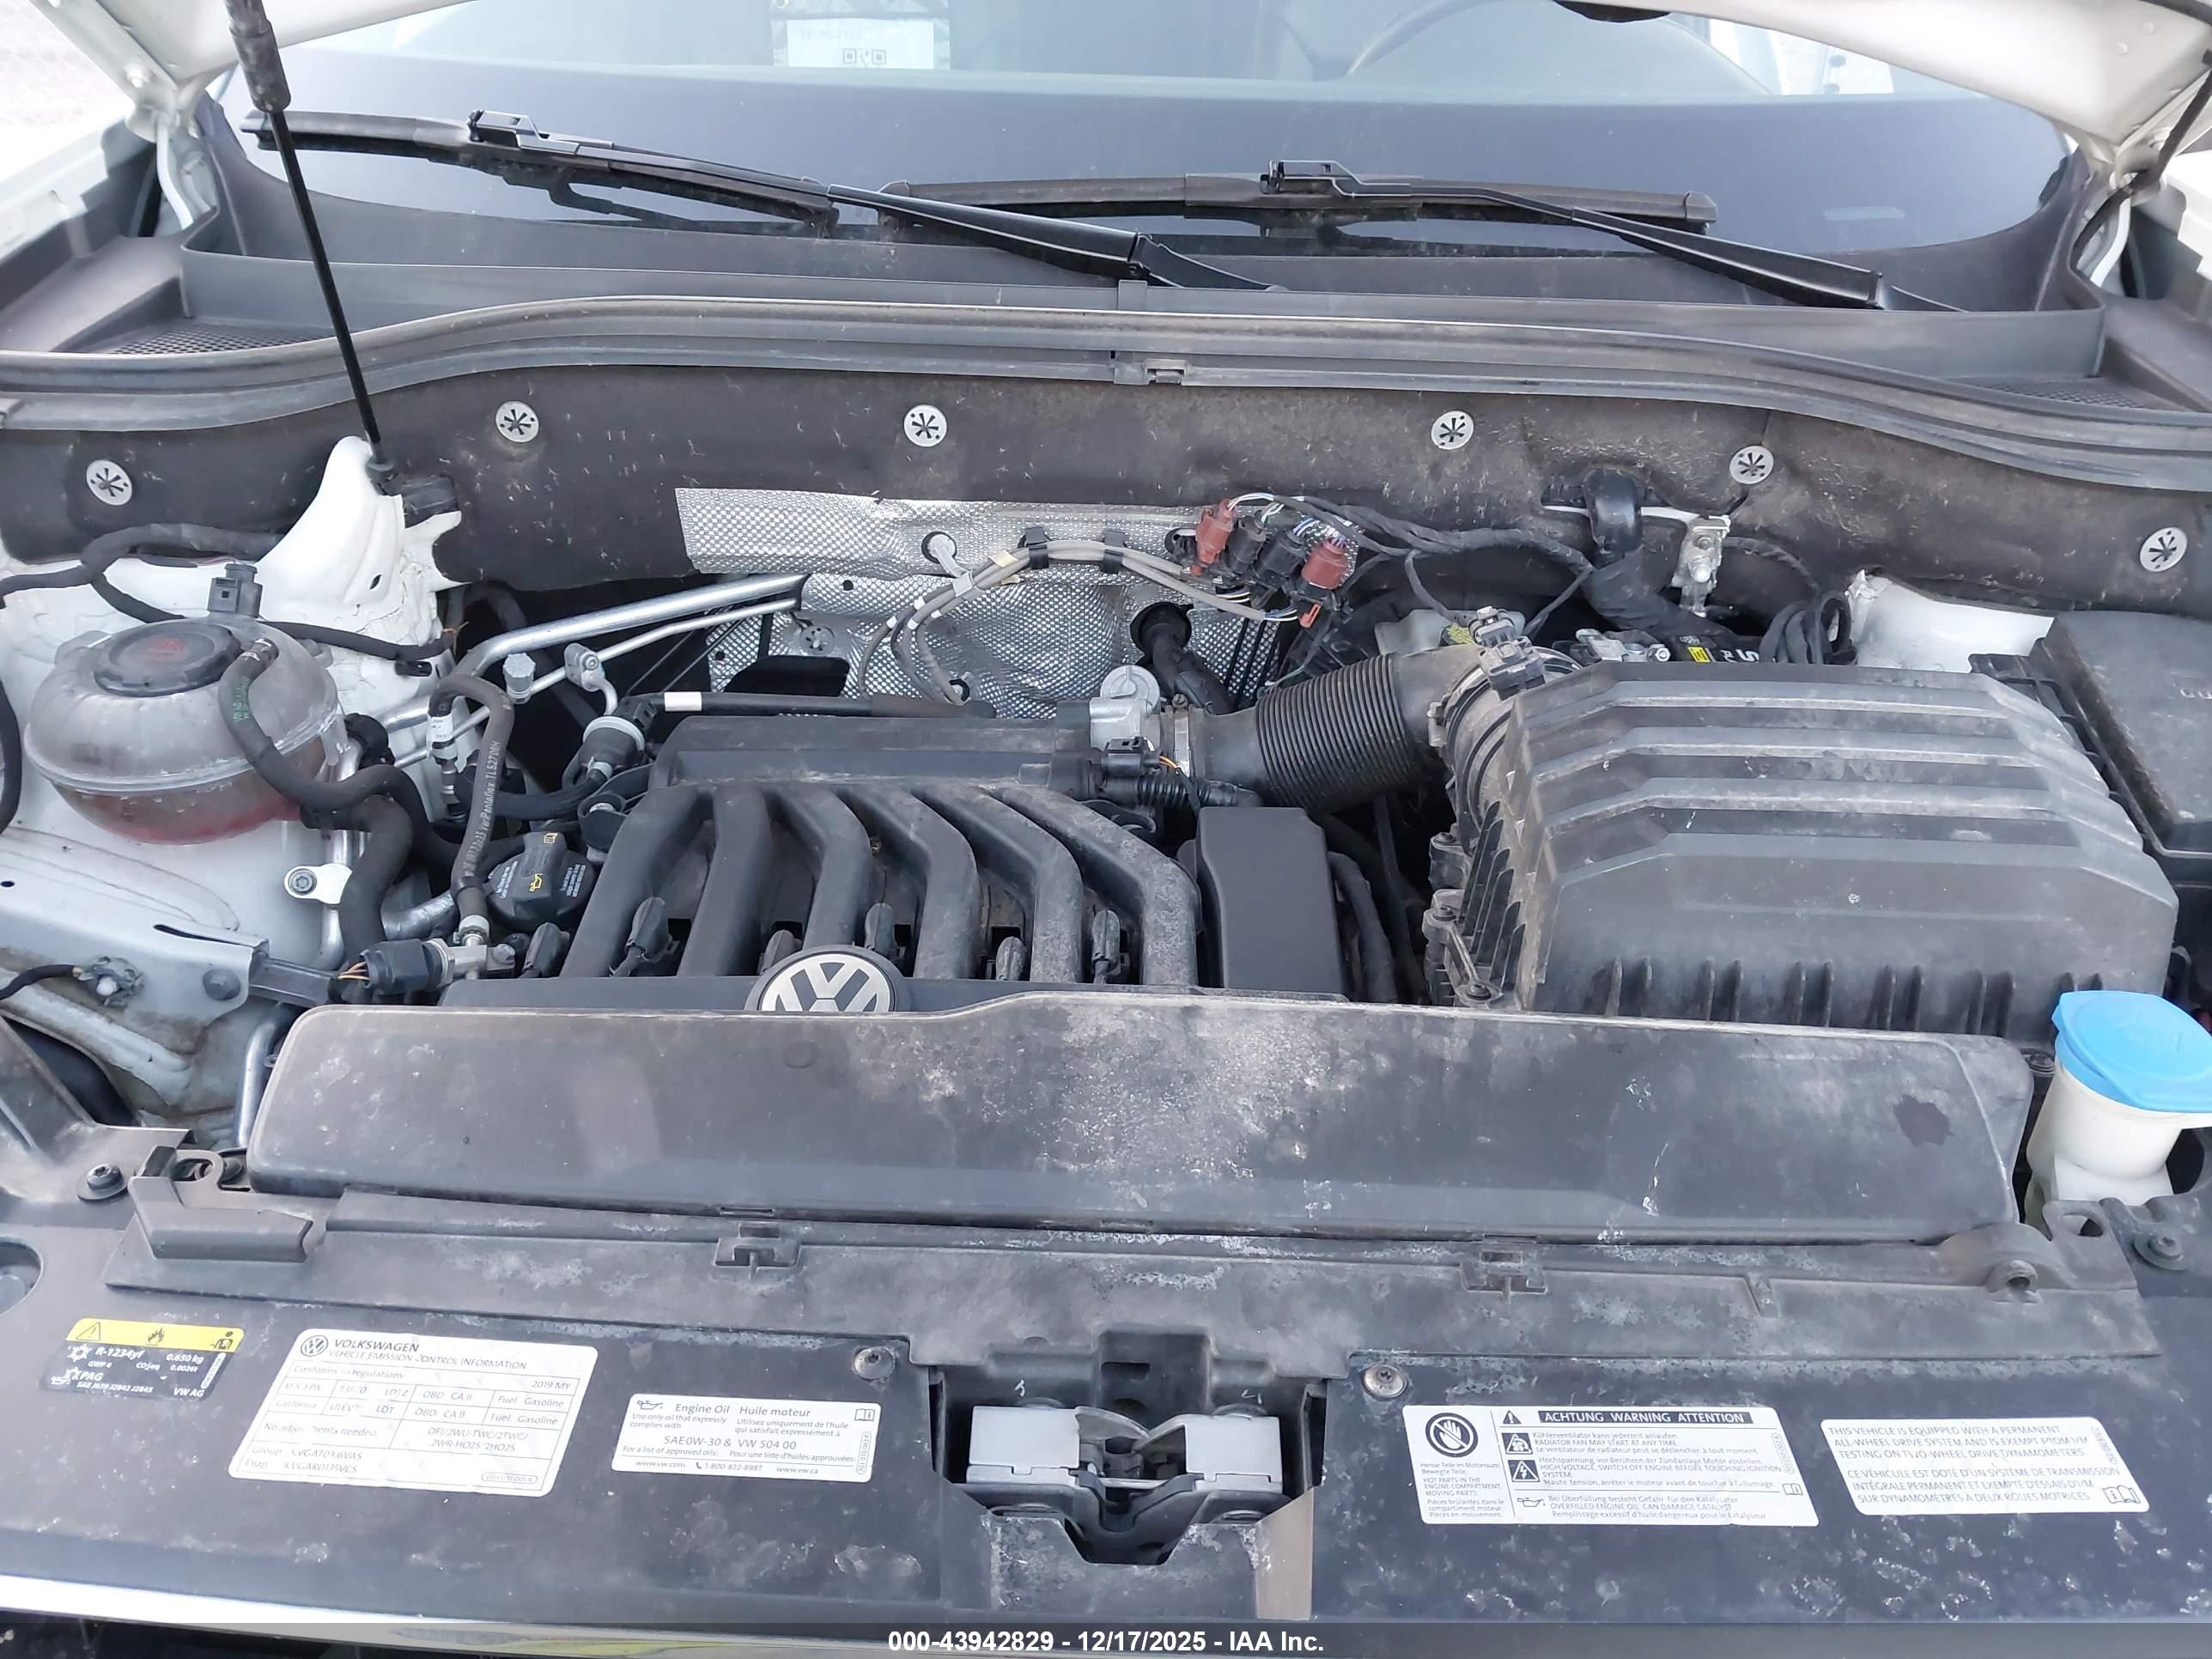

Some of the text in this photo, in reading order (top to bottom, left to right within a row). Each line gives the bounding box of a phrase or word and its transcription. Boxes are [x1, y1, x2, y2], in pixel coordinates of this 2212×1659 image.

[335, 1339, 419, 1352] VOLKSWAGEN
[95, 1347, 204, 1364] R-1234yf 0.650 kg
[367, 1352, 412, 1361] EMISSION
[461, 1358, 526, 1369] INFORMATION
[80, 1372, 103, 1381] PAG
[524, 1397, 564, 1407] Gasoline
[676, 1404, 712, 1414] Engine
[739, 1407, 768, 1415] Huile
[518, 1415, 558, 1425] Gasoline
[1545, 1413, 1745, 1423] ACHTUNG WARNING ATTENTION
[1853, 1427, 1894, 1436] VEHICLE
[1909, 1427, 1960, 1437] EQUIPPED
[1961, 1426, 1988, 1435] WITH
[2001, 1425, 2061, 1434] PERMANENT
[738, 1439, 757, 1448] VW
[760, 1440, 780, 1449] 504
[782, 1441, 796, 1449] 00
[1834, 1438, 1890, 1447] ALL-WHEEL
[1839, 1450, 1882, 1459] TESTING
[1904, 1449, 1967, 1458] TWO-WHEEL
[1968, 1449, 2000, 1458] DRIVE
[2046, 1467, 2121, 1476] TRANSMISSION
[1907, 1481, 1967, 1491] PERMANENT
[1857, 1494, 1877, 1504] SUR
[1976, 1493, 2002, 1502] DEUX
[2005, 1492, 2039, 1501] ROUES
